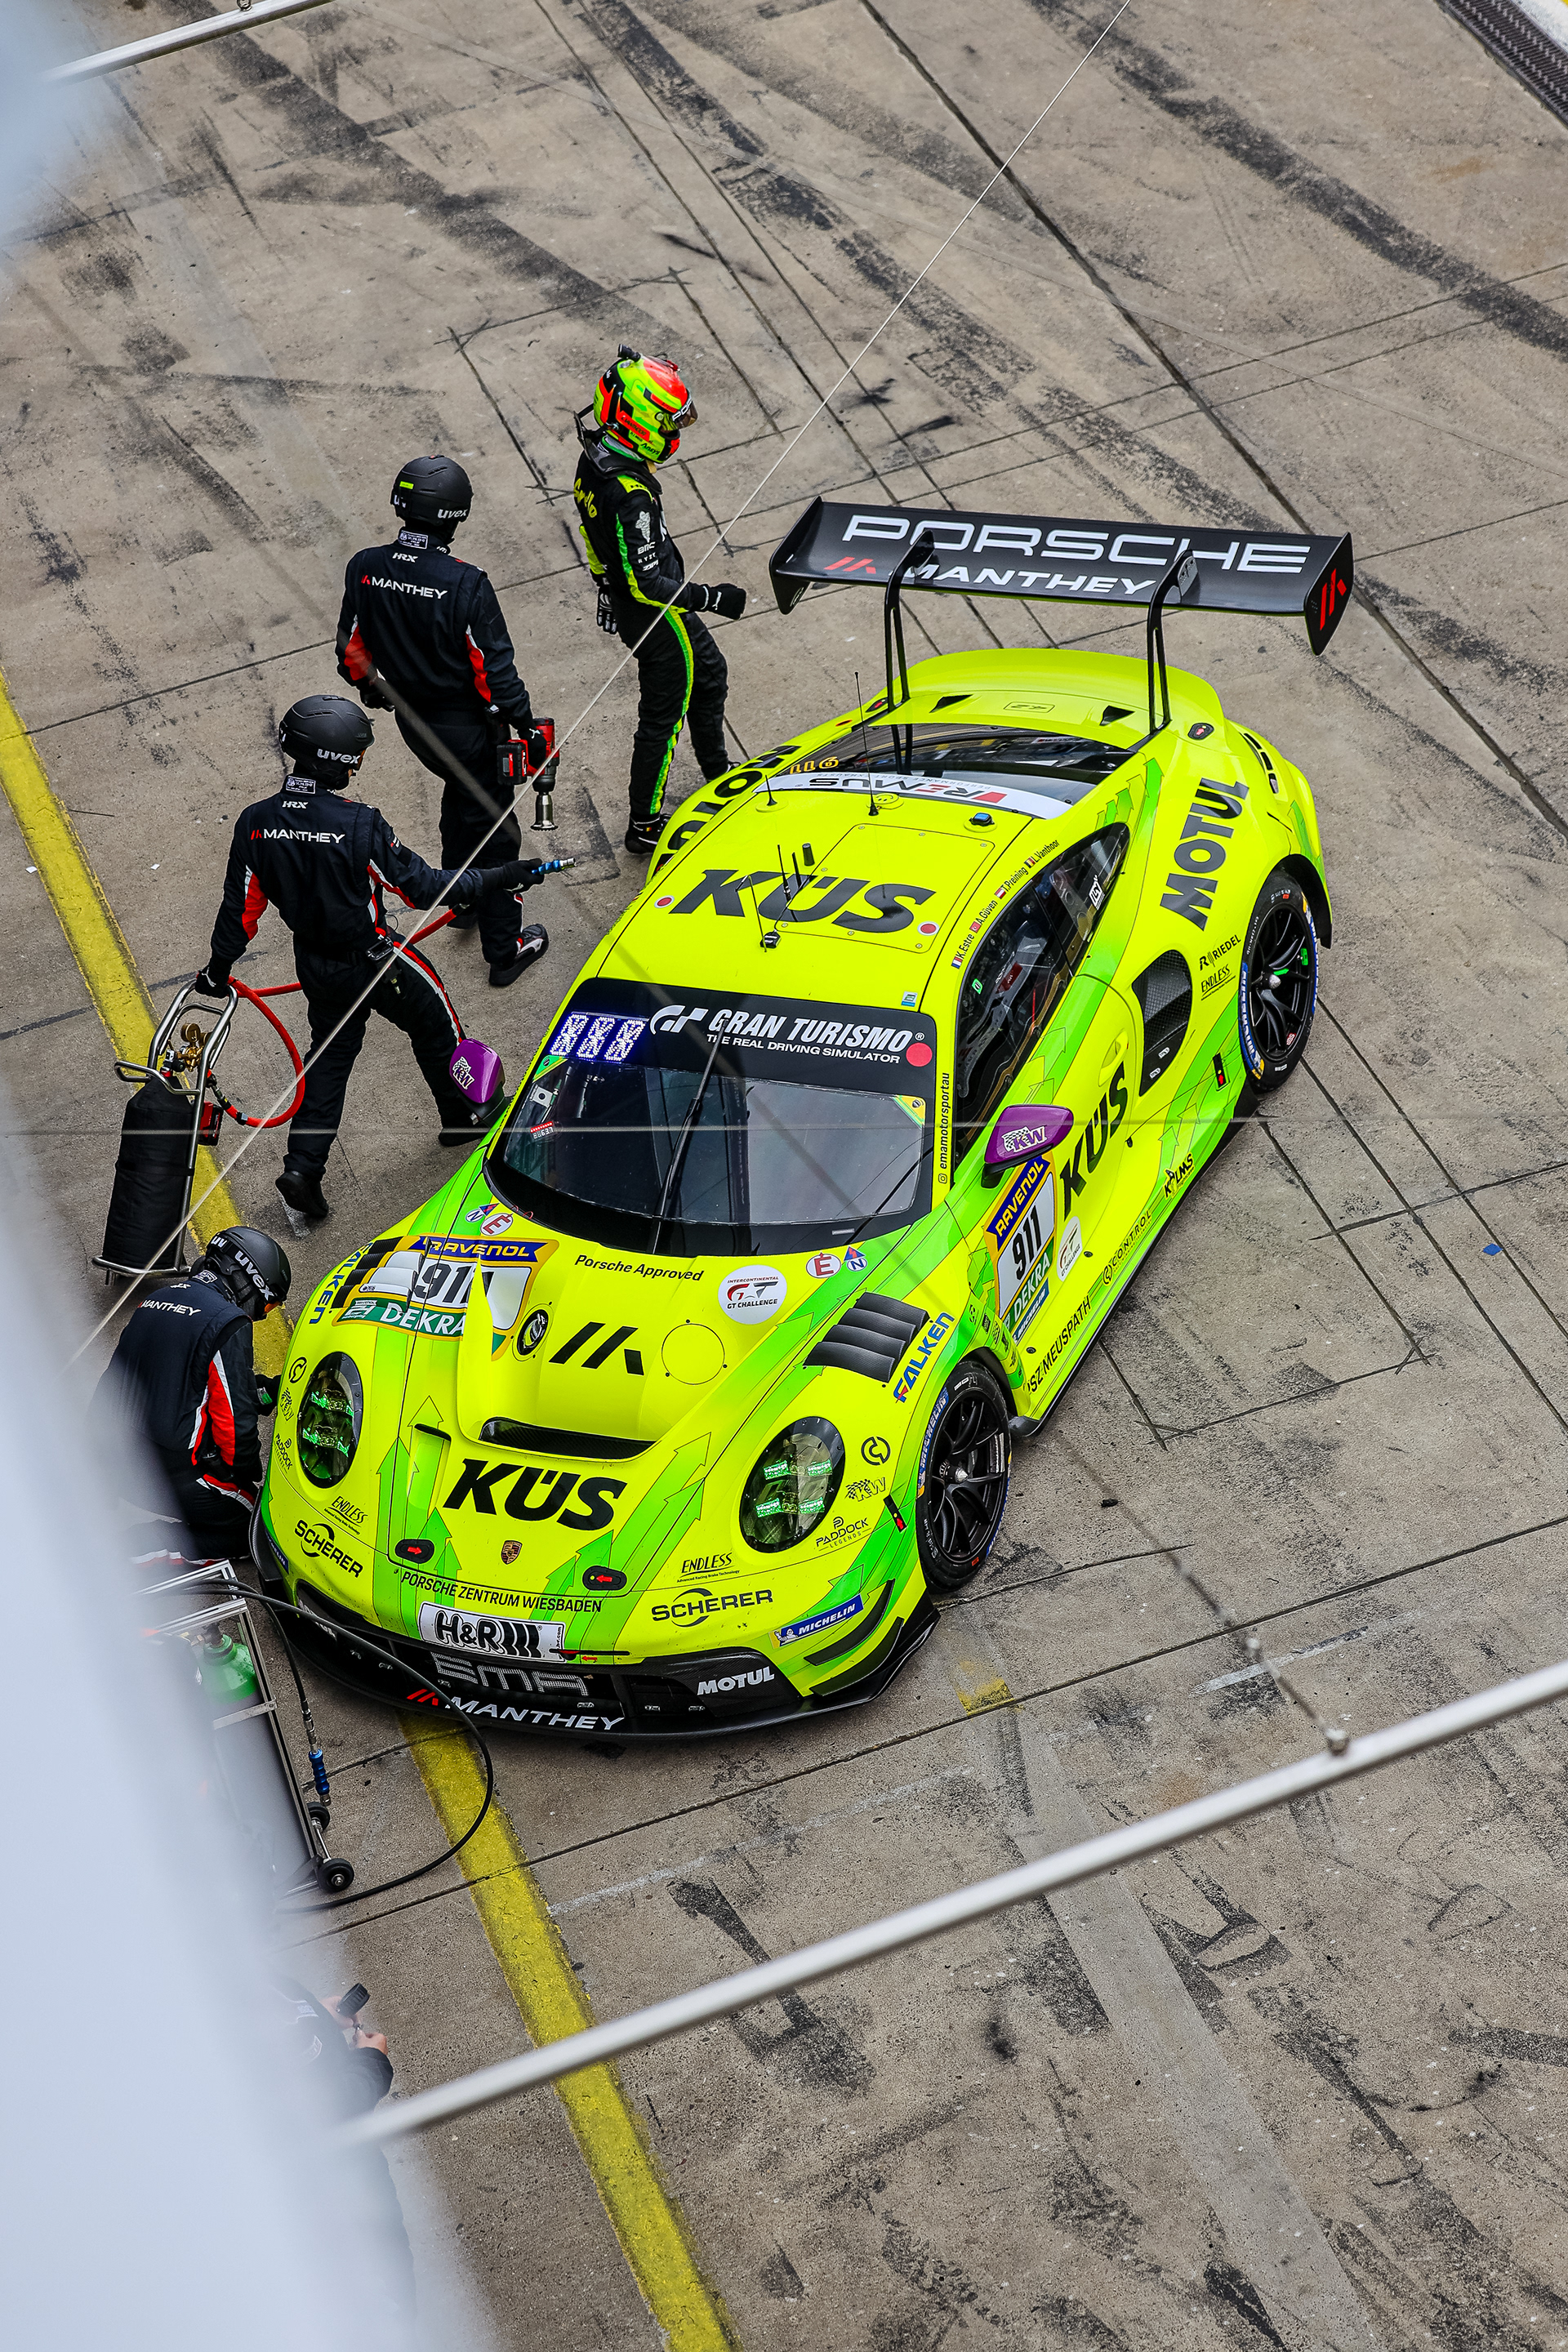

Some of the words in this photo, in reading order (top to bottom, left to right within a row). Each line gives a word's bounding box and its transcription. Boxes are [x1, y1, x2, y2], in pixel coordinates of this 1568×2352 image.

[438, 509, 468, 519] uvex
[392, 553, 418, 563] HRX
[842, 514, 1311, 574] PORSCHE
[372, 577, 448, 599] MANTHEY
[889, 564, 1156, 595] MANTHEY
[317, 749, 361, 764] uvex
[808, 777, 976, 800] REMUS
[282, 800, 309, 809] HRX
[263, 828, 345, 844] MANTHEY
[1034, 840, 1060, 864] L.Vanthoor
[1160, 777, 1250, 931] MOTUL
[1001, 866, 1029, 893] T.Preining
[668, 868, 937, 934] KÜS
[976, 899, 998, 926] A.Güven
[956, 933, 975, 960] K.Estre
[1212, 934, 1241, 960] RIEDEL
[1200, 964, 1232, 992] ENDLESS
[708, 1009, 787, 1039] GRAN
[789, 1018, 913, 1052] TURISMO
[728, 1037, 764, 1049] REAL
[768, 1042, 820, 1056] DRIVING
[822, 1047, 901, 1064] SIMULATOR
[940, 1072, 950, 1169] emamotorsportau
[1013, 1125, 1046, 1151] KW
[1059, 1061, 1128, 1222] KÜS
[995, 1160, 1044, 1236] RAVENOL
[422, 1236, 530, 1258] RAVENOL
[1012, 1205, 1042, 1281] 911
[1111, 1209, 1152, 1267] CONTROL
[234, 1250, 274, 1301] uvex
[575, 1254, 632, 1274] Porsche
[633, 1263, 704, 1282] Approved
[727, 1276, 779, 1284] INTERCONTINENTAL
[1013, 1251, 1051, 1323] DEKRA
[727, 1302, 736, 1310] GT
[737, 1298, 778, 1309] CHALLENGE
[1018, 1288, 1046, 1339] MICHELIN
[1043, 1295, 1091, 1375] MEUSPATH
[893, 1312, 956, 1403] FALKEN
[274, 1432, 293, 1470] PADDOCK
[331, 1495, 368, 1524] ENDLESS
[443, 1458, 628, 1531] KÜS
[816, 1517, 869, 1548] PADDOCK
[828, 1531, 862, 1548] LEGENDS
[294, 1519, 363, 1579] SCHERER
[681, 1552, 733, 1574] ENDLESS
[718, 1569, 740, 1578] Technology
[401, 1571, 457, 1597] PORSCHE
[458, 1586, 520, 1608] ZENTRUM
[522, 1595, 603, 1613] WIESBADEN
[651, 1588, 773, 1622] SCHERER
[435, 1610, 501, 1652] H&R
[798, 1603, 856, 1635] MICHELIN
[697, 1666, 775, 1696] MOTUL
[445, 1695, 626, 1731] MANTHEY
